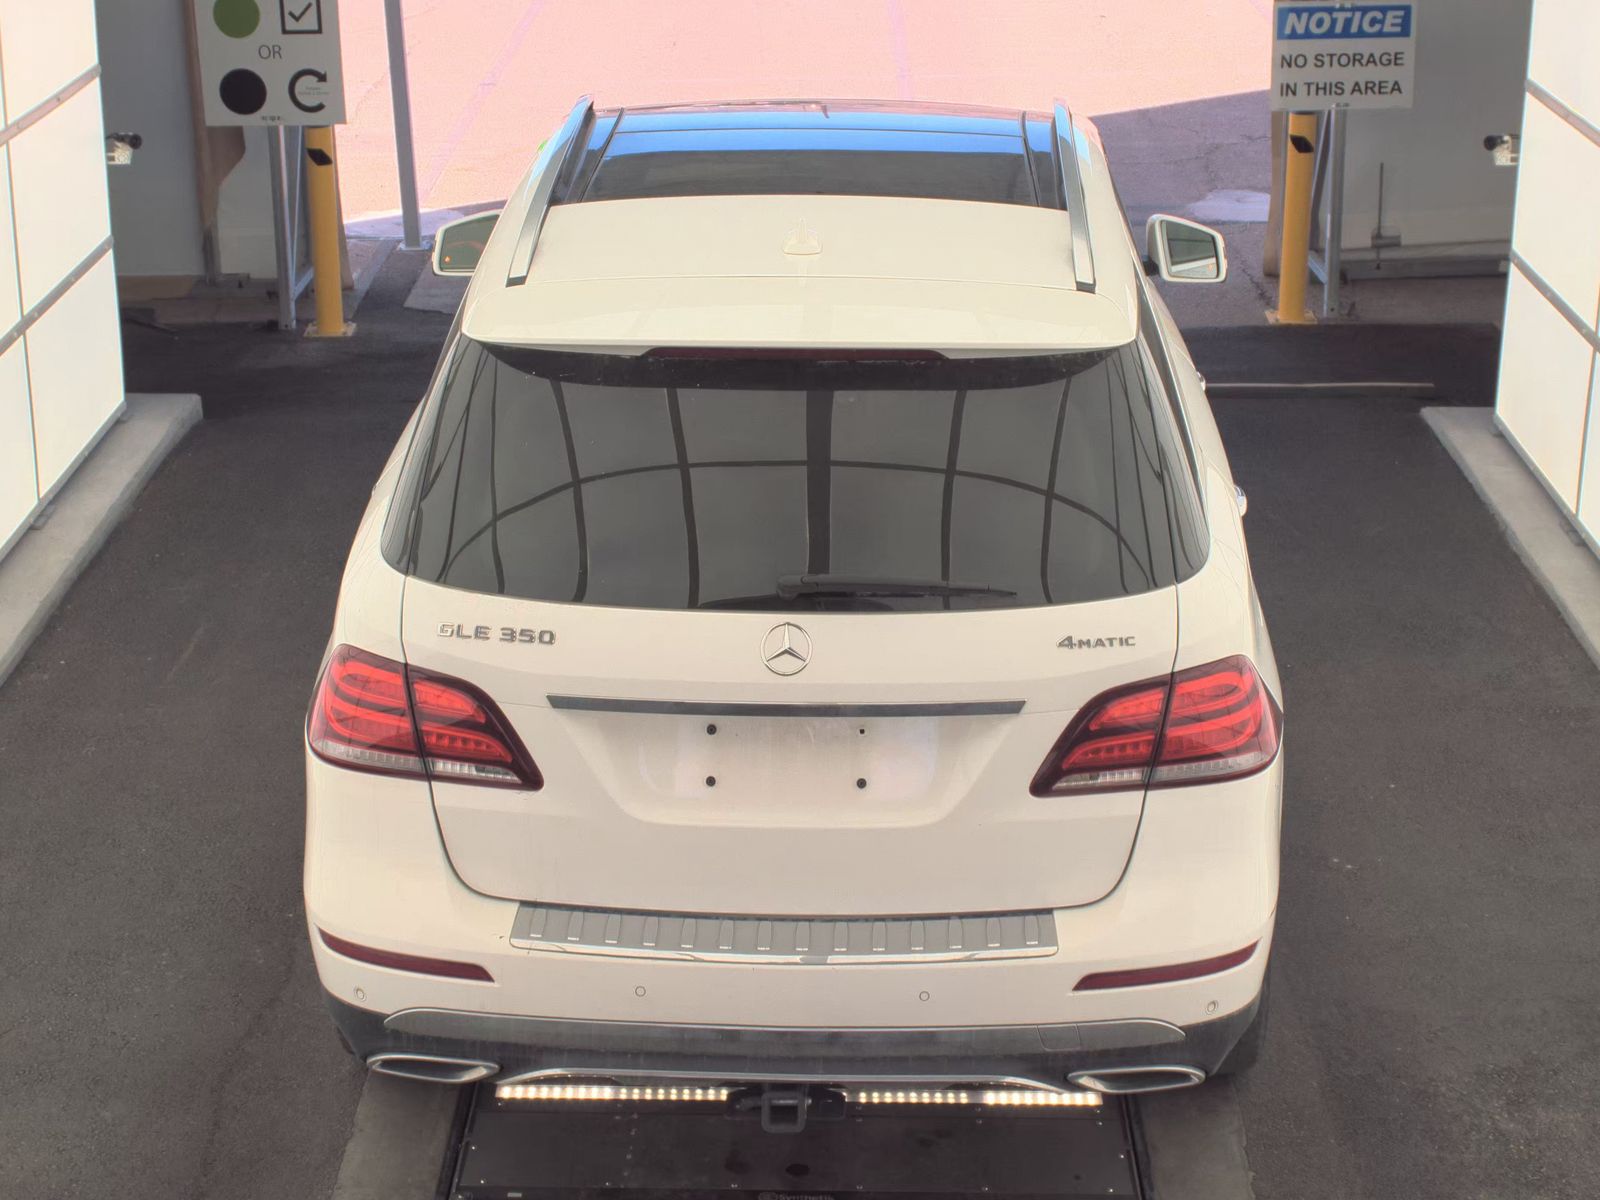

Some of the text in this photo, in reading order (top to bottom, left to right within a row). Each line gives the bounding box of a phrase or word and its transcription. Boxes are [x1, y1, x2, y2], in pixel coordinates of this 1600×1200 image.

[1285, 10, 1405, 35] NOTICE
[258, 44, 282, 60] OR
[1280, 52, 1405, 69] NO STORAGE
[1280, 80, 1403, 97] IN THIS AREA
[438, 622, 556, 645] GLE 350
[1056, 635, 1136, 650] 4MATIC
